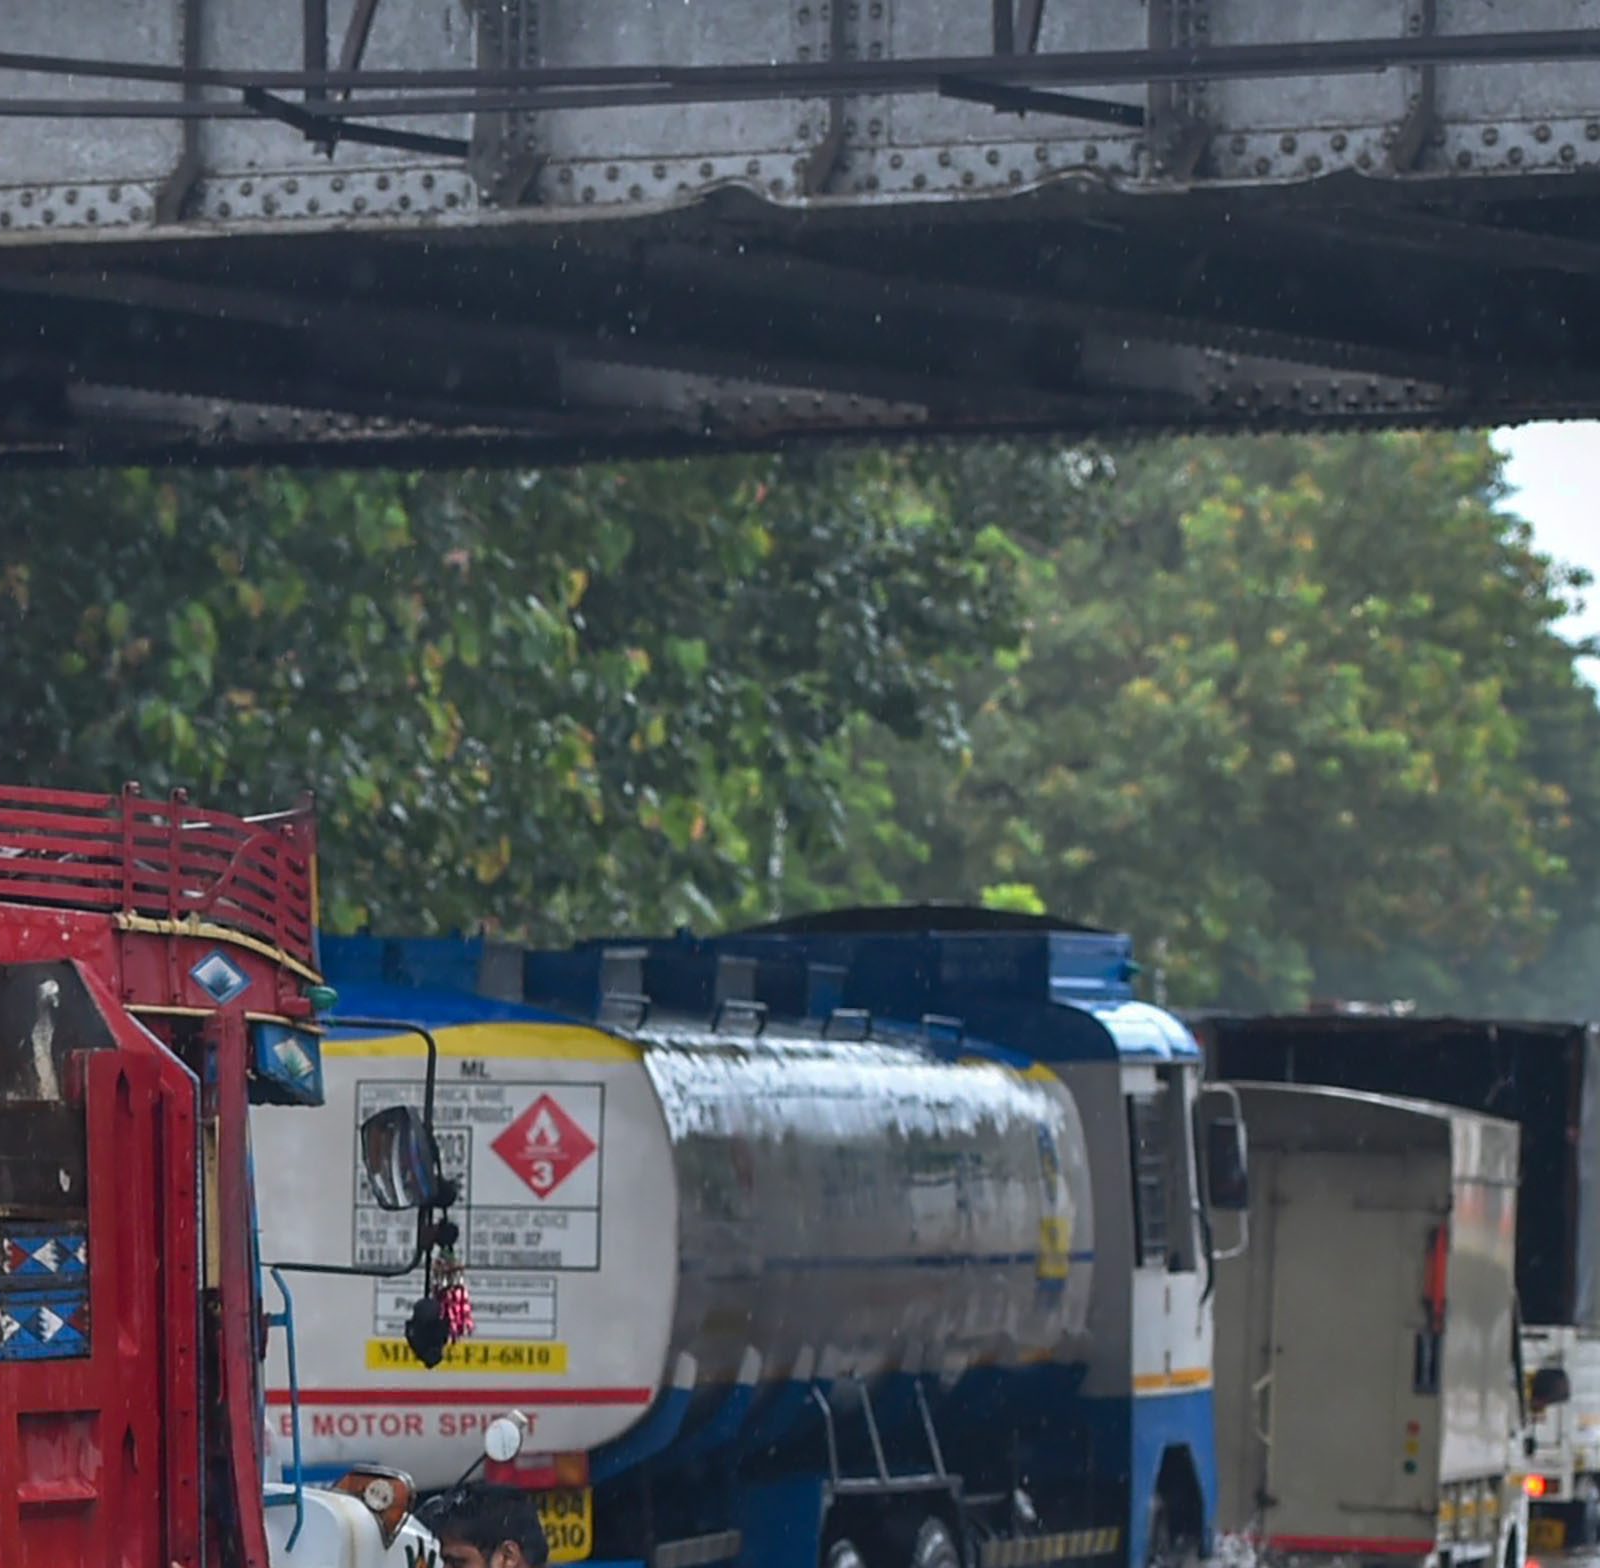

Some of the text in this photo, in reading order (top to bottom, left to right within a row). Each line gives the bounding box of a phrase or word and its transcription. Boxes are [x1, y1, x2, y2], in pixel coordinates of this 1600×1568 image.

[530, 1160, 555, 1189] 3
[312, 1413, 423, 1438] MOTOR
[438, 1413, 539, 1438] SPIT
